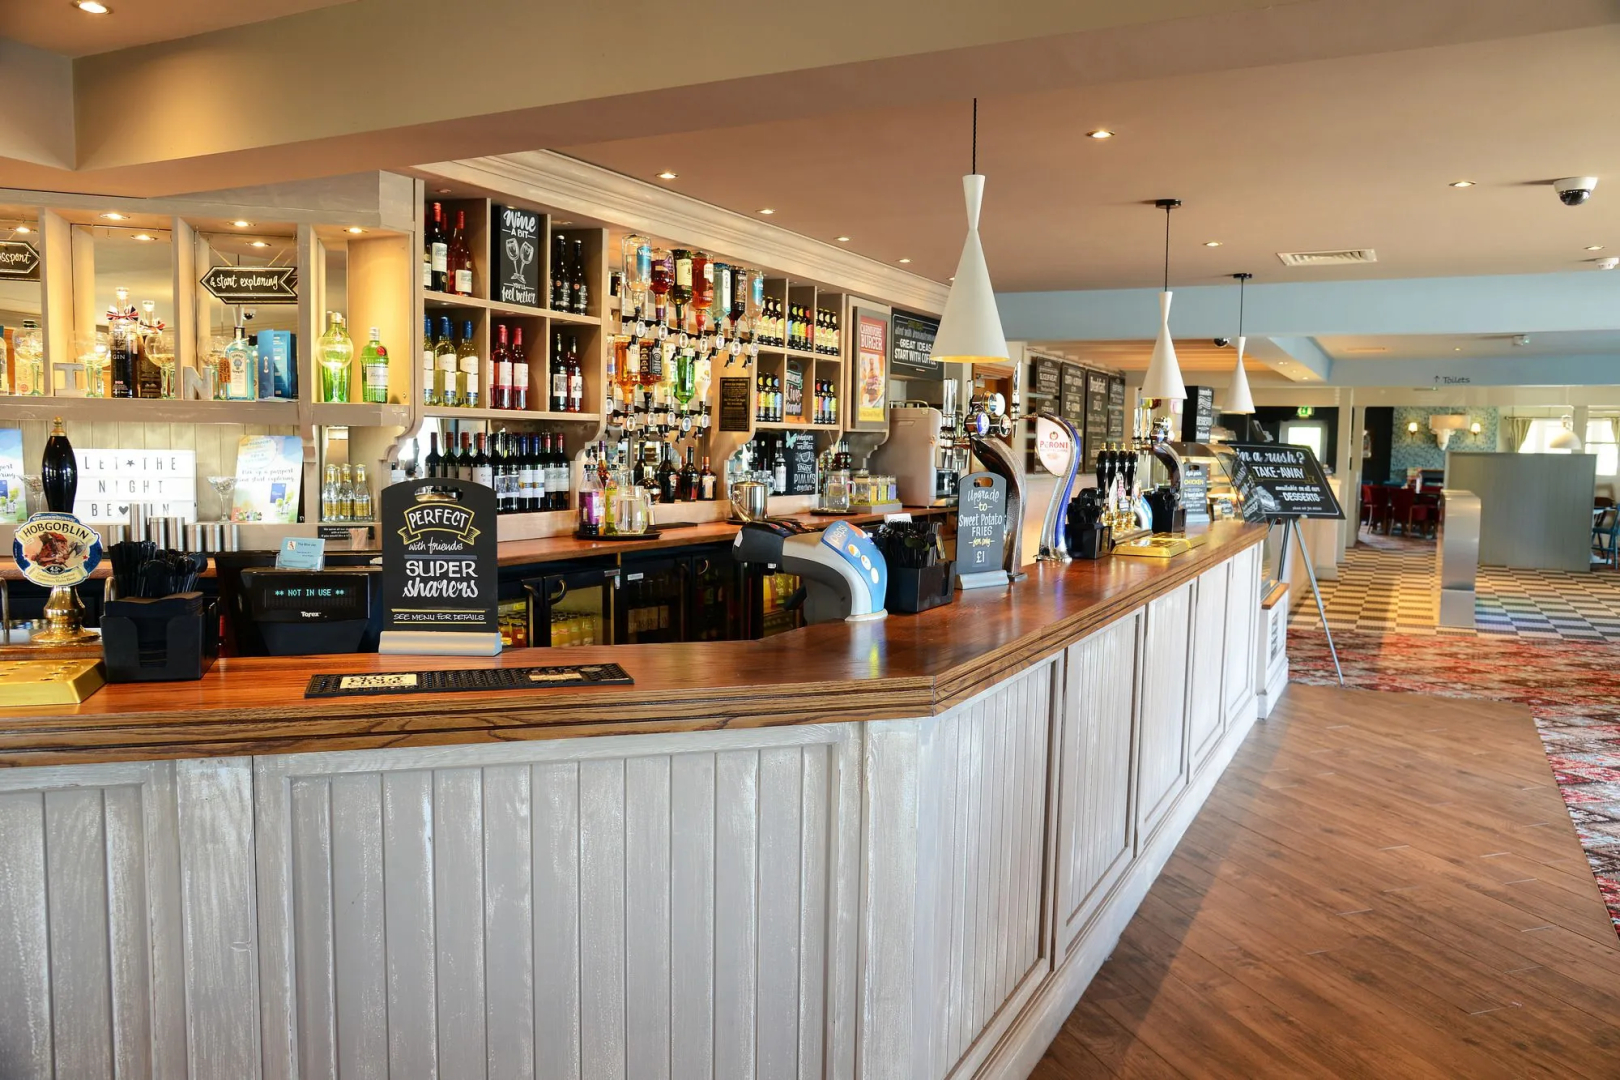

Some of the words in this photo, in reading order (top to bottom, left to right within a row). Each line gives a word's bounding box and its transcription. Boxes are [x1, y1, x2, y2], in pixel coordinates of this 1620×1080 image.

[503, 210, 536, 232] Wine
[518, 230, 528, 238] BIT
[0, 252, 31, 265] ssport
[217, 274, 237, 288] start
[240, 275, 278, 290] exploring
[502, 286, 515, 302] feel
[516, 290, 536, 304] better
[861, 324, 882, 337] CARNIVORE
[861, 334, 882, 350] BURGER
[900, 338, 916, 349] GREAT
[917, 341, 932, 352] IDEAS
[895, 348, 909, 360] START
[909, 350, 921, 362] WITH
[1040, 440, 1068, 449] PERONI
[85, 456, 118, 470] LET
[144, 457, 176, 470] THE
[1252, 451, 1262, 462] a
[1252, 466, 1304, 479] TAKE-AWAY
[99, 480, 162, 493] NIGHT
[968, 488, 999, 505] Upgrade
[1283, 492, 1320, 502] DESSERTS
[978, 501, 988, 511] to
[408, 508, 469, 528] PERFECT
[959, 514, 979, 526] Sweet
[980, 513, 1002, 526] Potato
[23, 522, 89, 539] HOBGOBLIN
[972, 526, 992, 537] FRIES
[408, 540, 426, 551] with
[428, 537, 463, 554] friends
[976, 551, 985, 563] £1
[405, 560, 478, 578] SUPER
[402, 577, 479, 598] sharers
